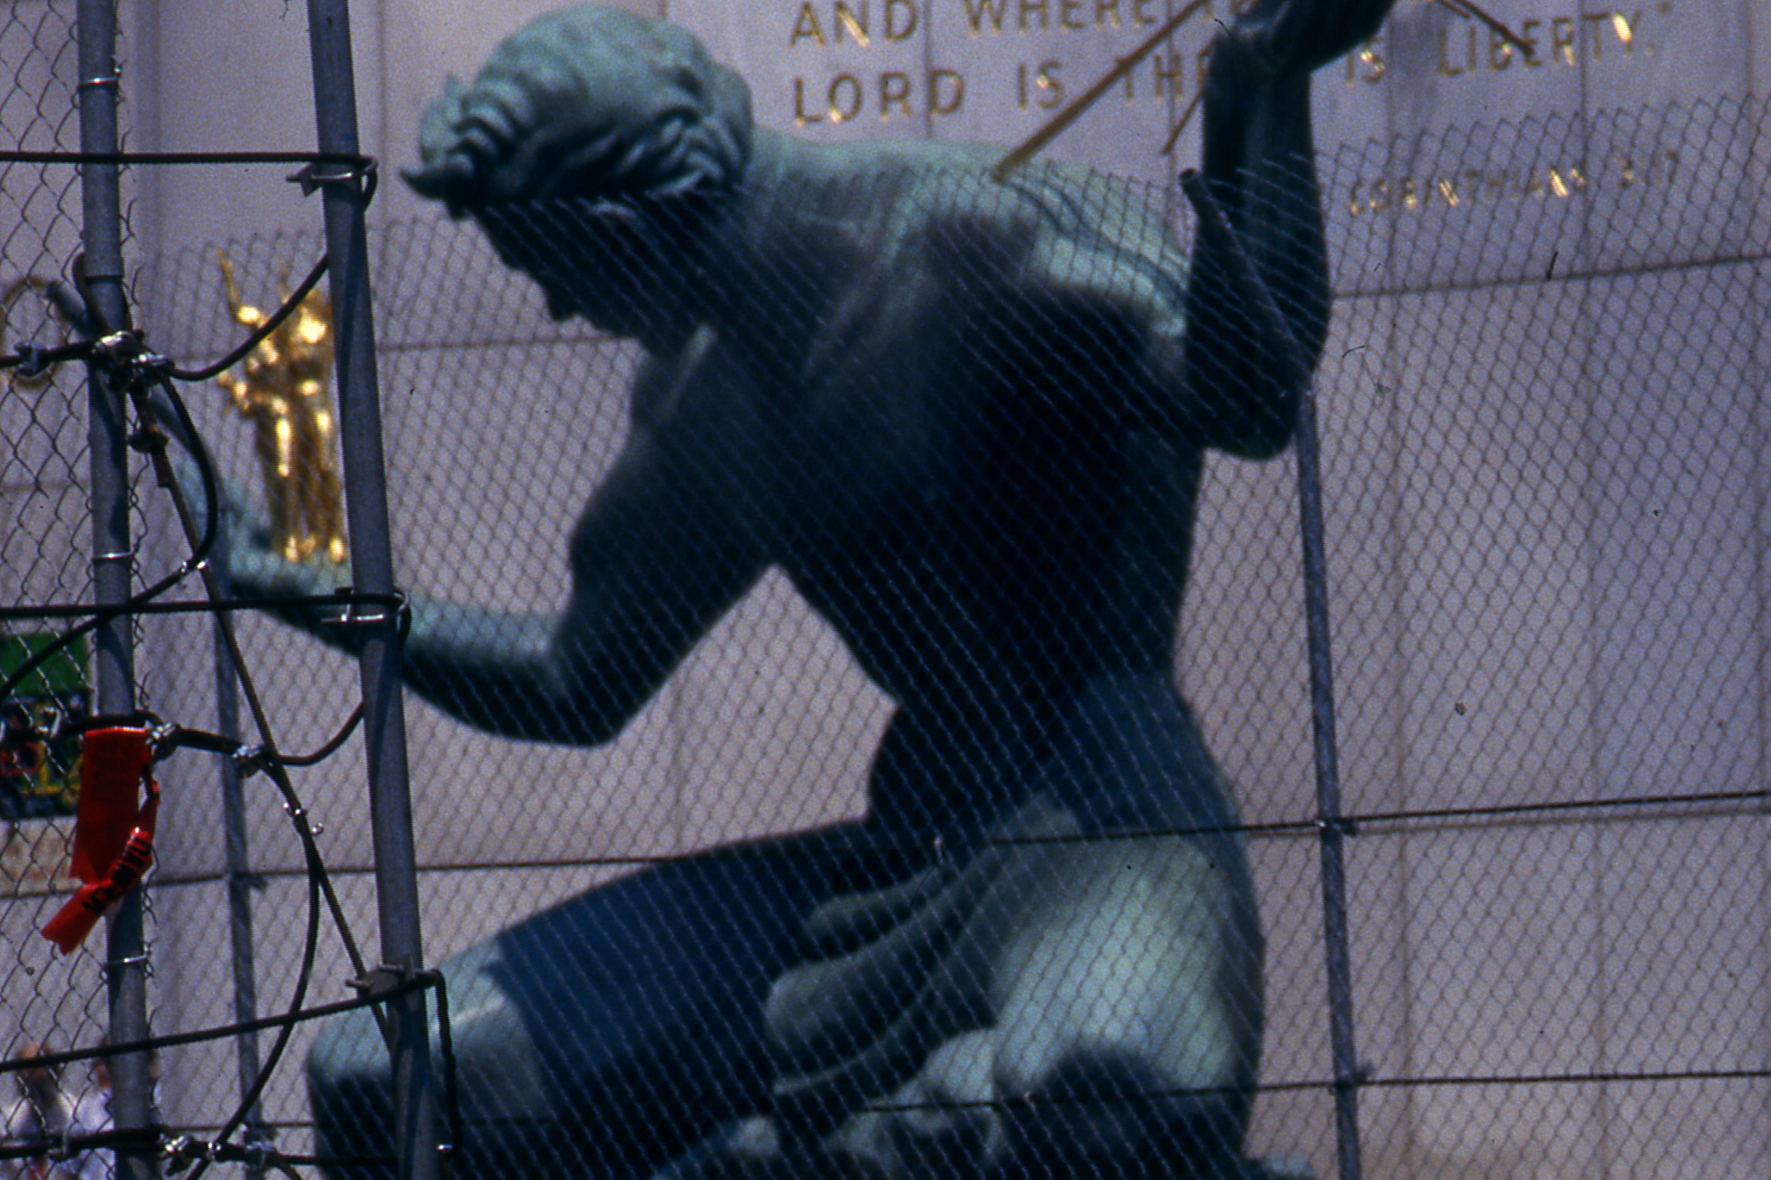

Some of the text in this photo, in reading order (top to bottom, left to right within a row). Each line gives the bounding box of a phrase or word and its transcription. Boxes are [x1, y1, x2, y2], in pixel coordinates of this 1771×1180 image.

[789, 0, 921, 48] AND
[794, 68, 966, 126] LORD
[1017, 60, 1064, 109] IS
